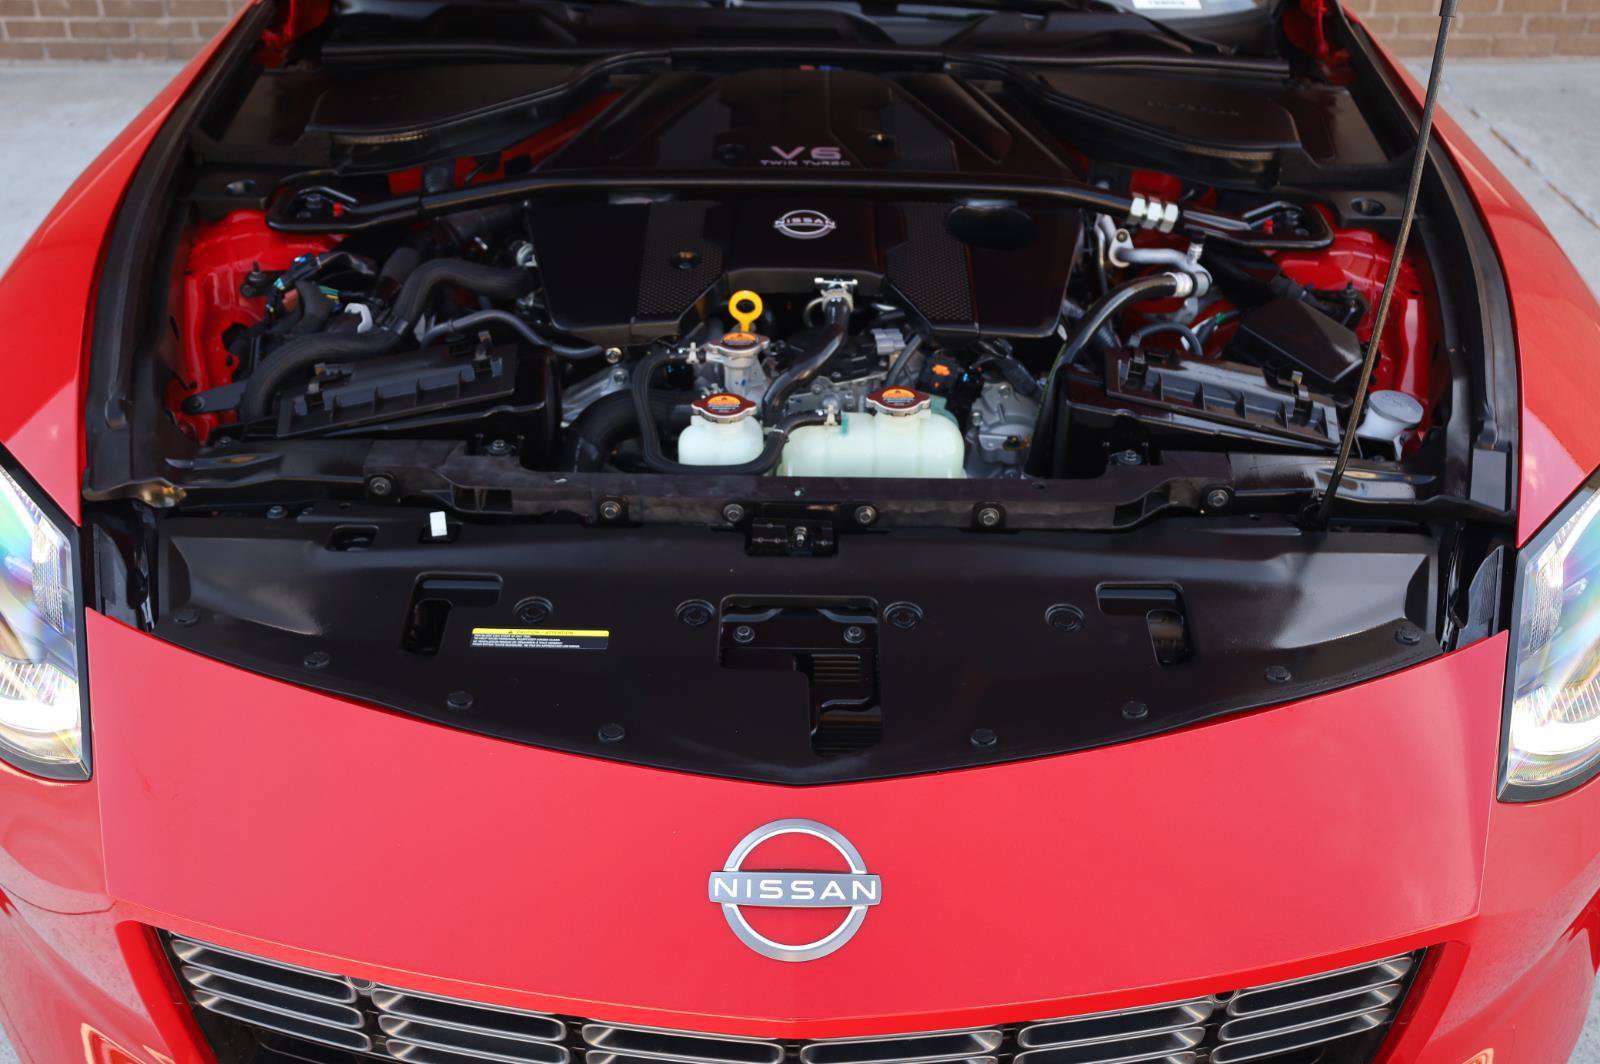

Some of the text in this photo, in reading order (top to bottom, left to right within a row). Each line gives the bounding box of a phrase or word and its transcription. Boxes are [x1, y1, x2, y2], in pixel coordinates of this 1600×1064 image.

[770, 145, 842, 160] V6
[774, 217, 836, 228] NISSAN
[714, 877, 877, 901] NISSAN
